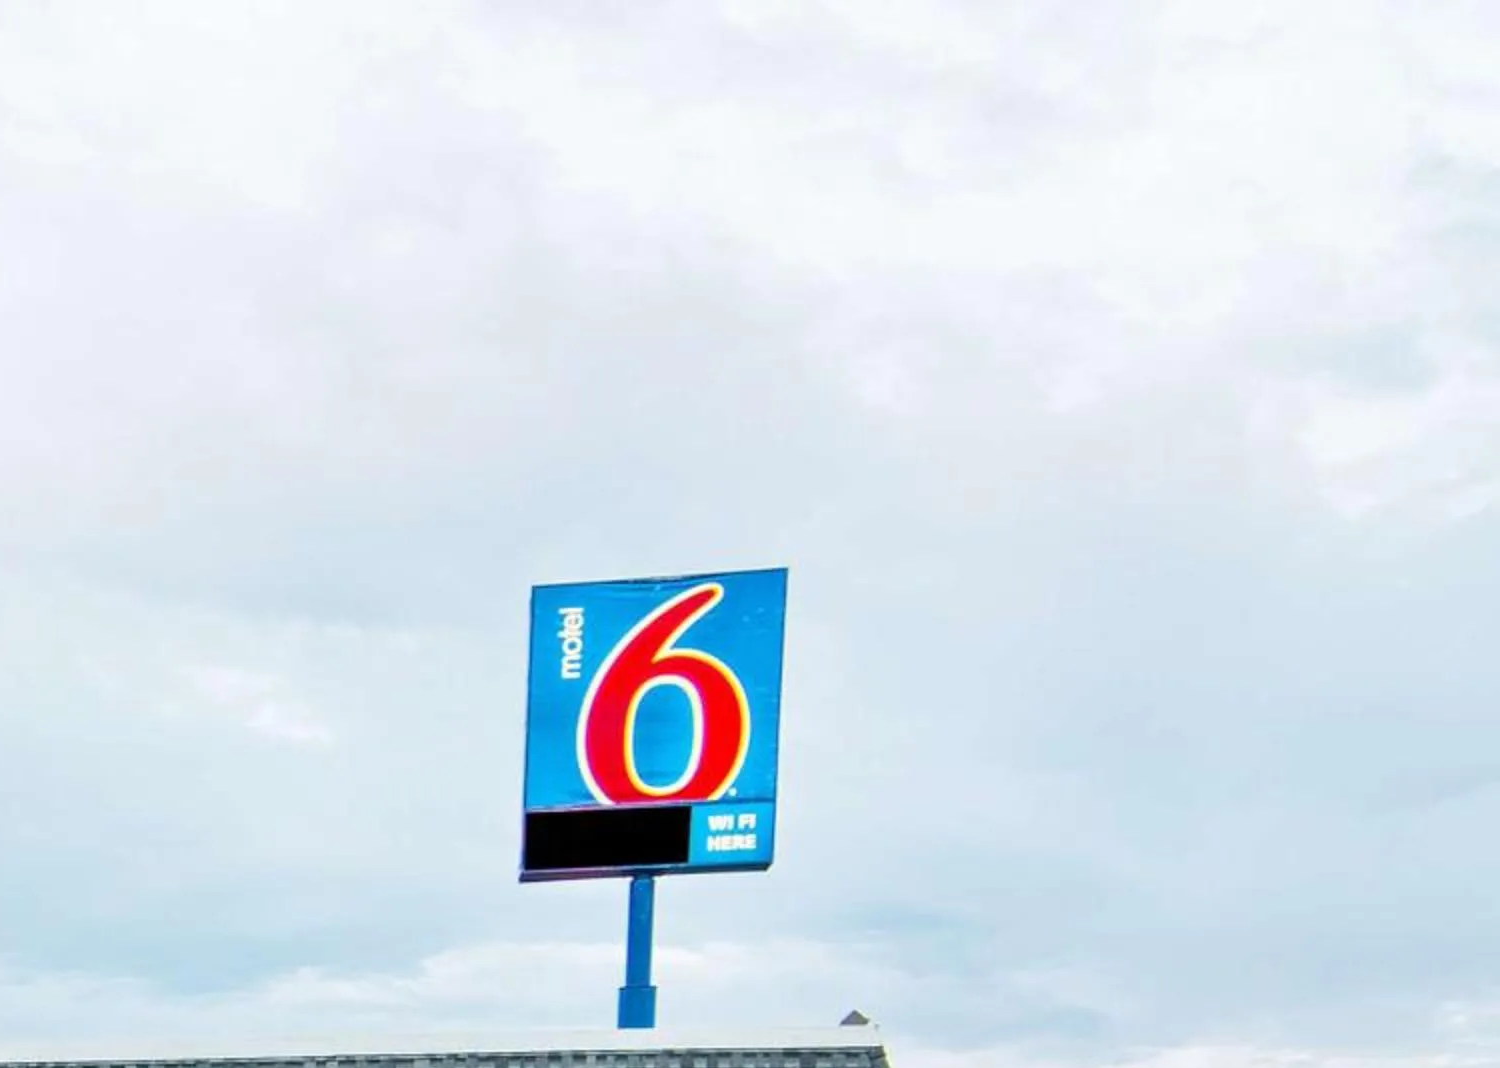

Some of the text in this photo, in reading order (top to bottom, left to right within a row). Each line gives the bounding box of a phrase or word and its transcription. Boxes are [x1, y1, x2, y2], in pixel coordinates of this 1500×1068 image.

[557, 607, 584, 679] motel
[576, 582, 750, 805] 6
[706, 834, 757, 852] HERE
[707, 813, 757, 831] WI FI
